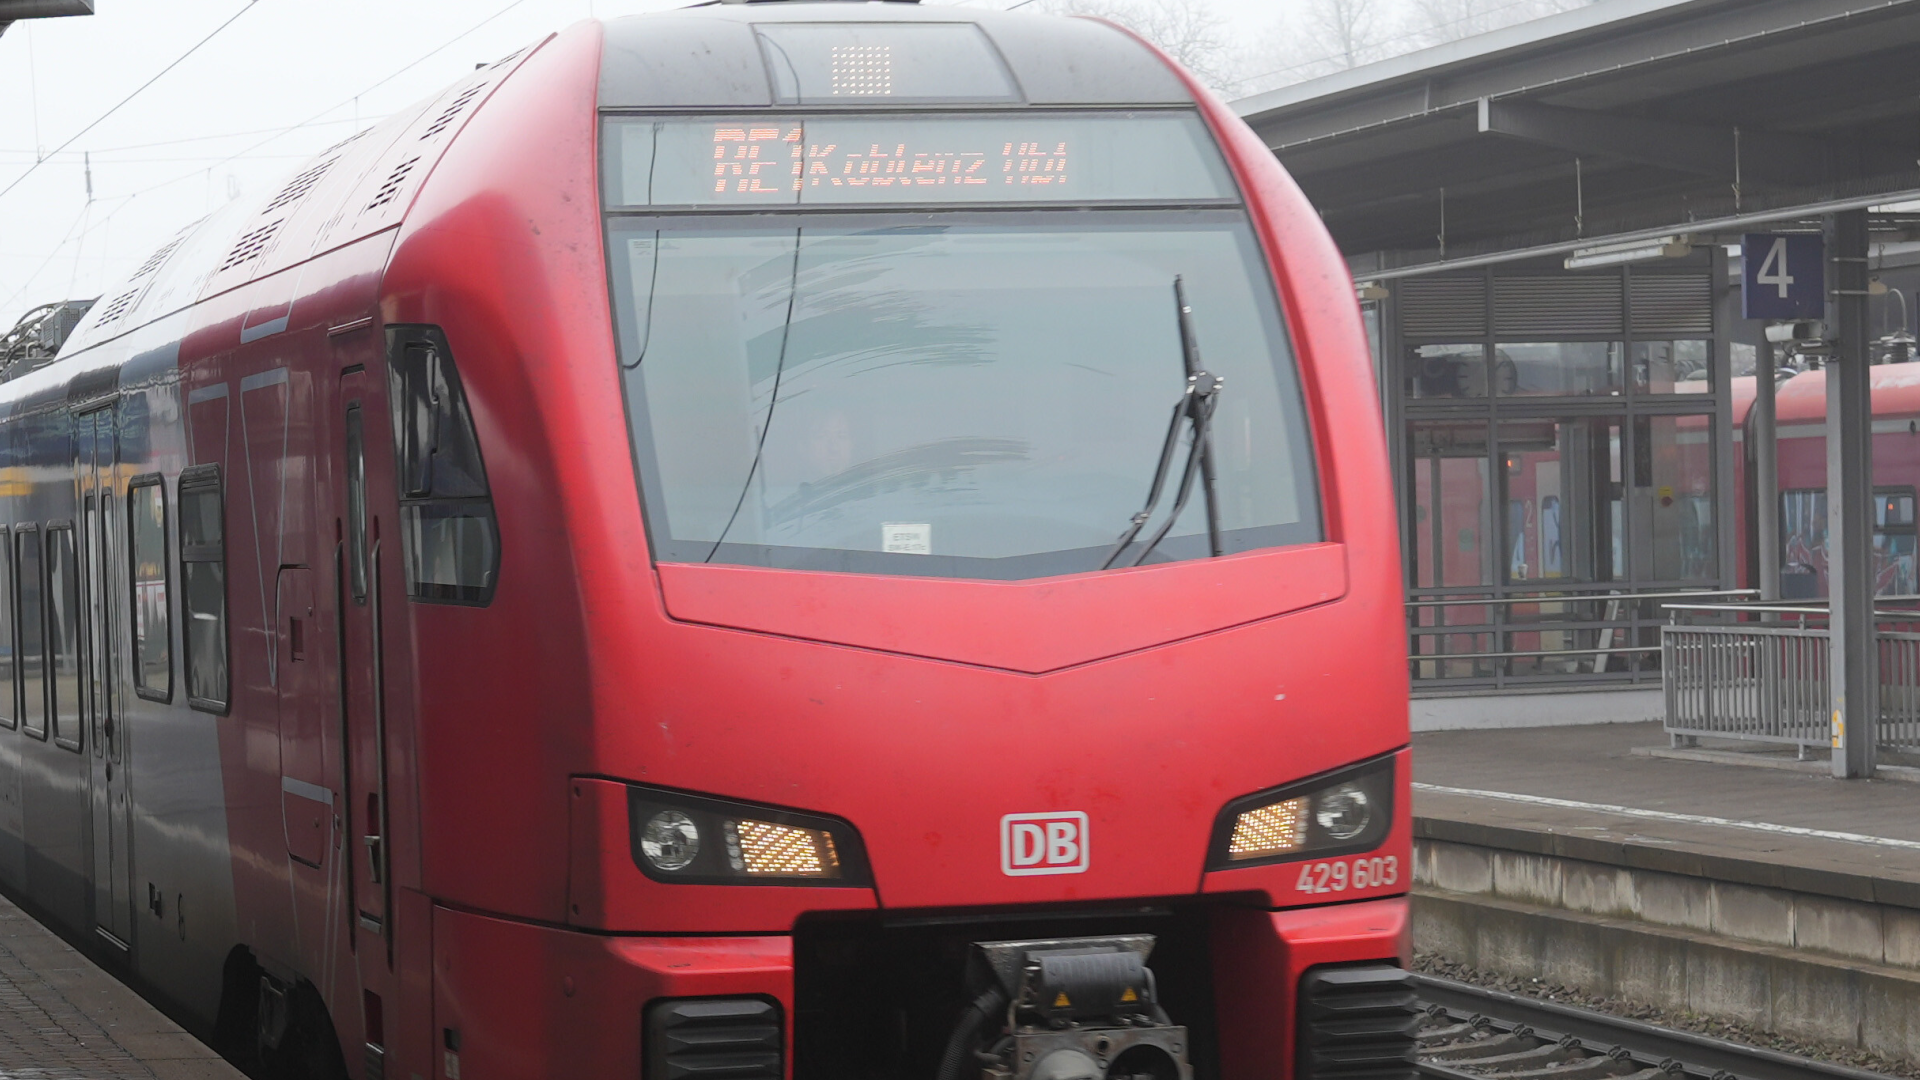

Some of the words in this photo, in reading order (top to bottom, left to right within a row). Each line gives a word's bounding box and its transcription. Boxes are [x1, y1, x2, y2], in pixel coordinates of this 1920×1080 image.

[713, 126, 803, 192] RE1
[808, 143, 987, 186] Koblenz
[1757, 237, 1794, 298] 4
[1010, 821, 1081, 867] DB
[1295, 861, 1349, 894] 429
[1352, 855, 1399, 889] 603
